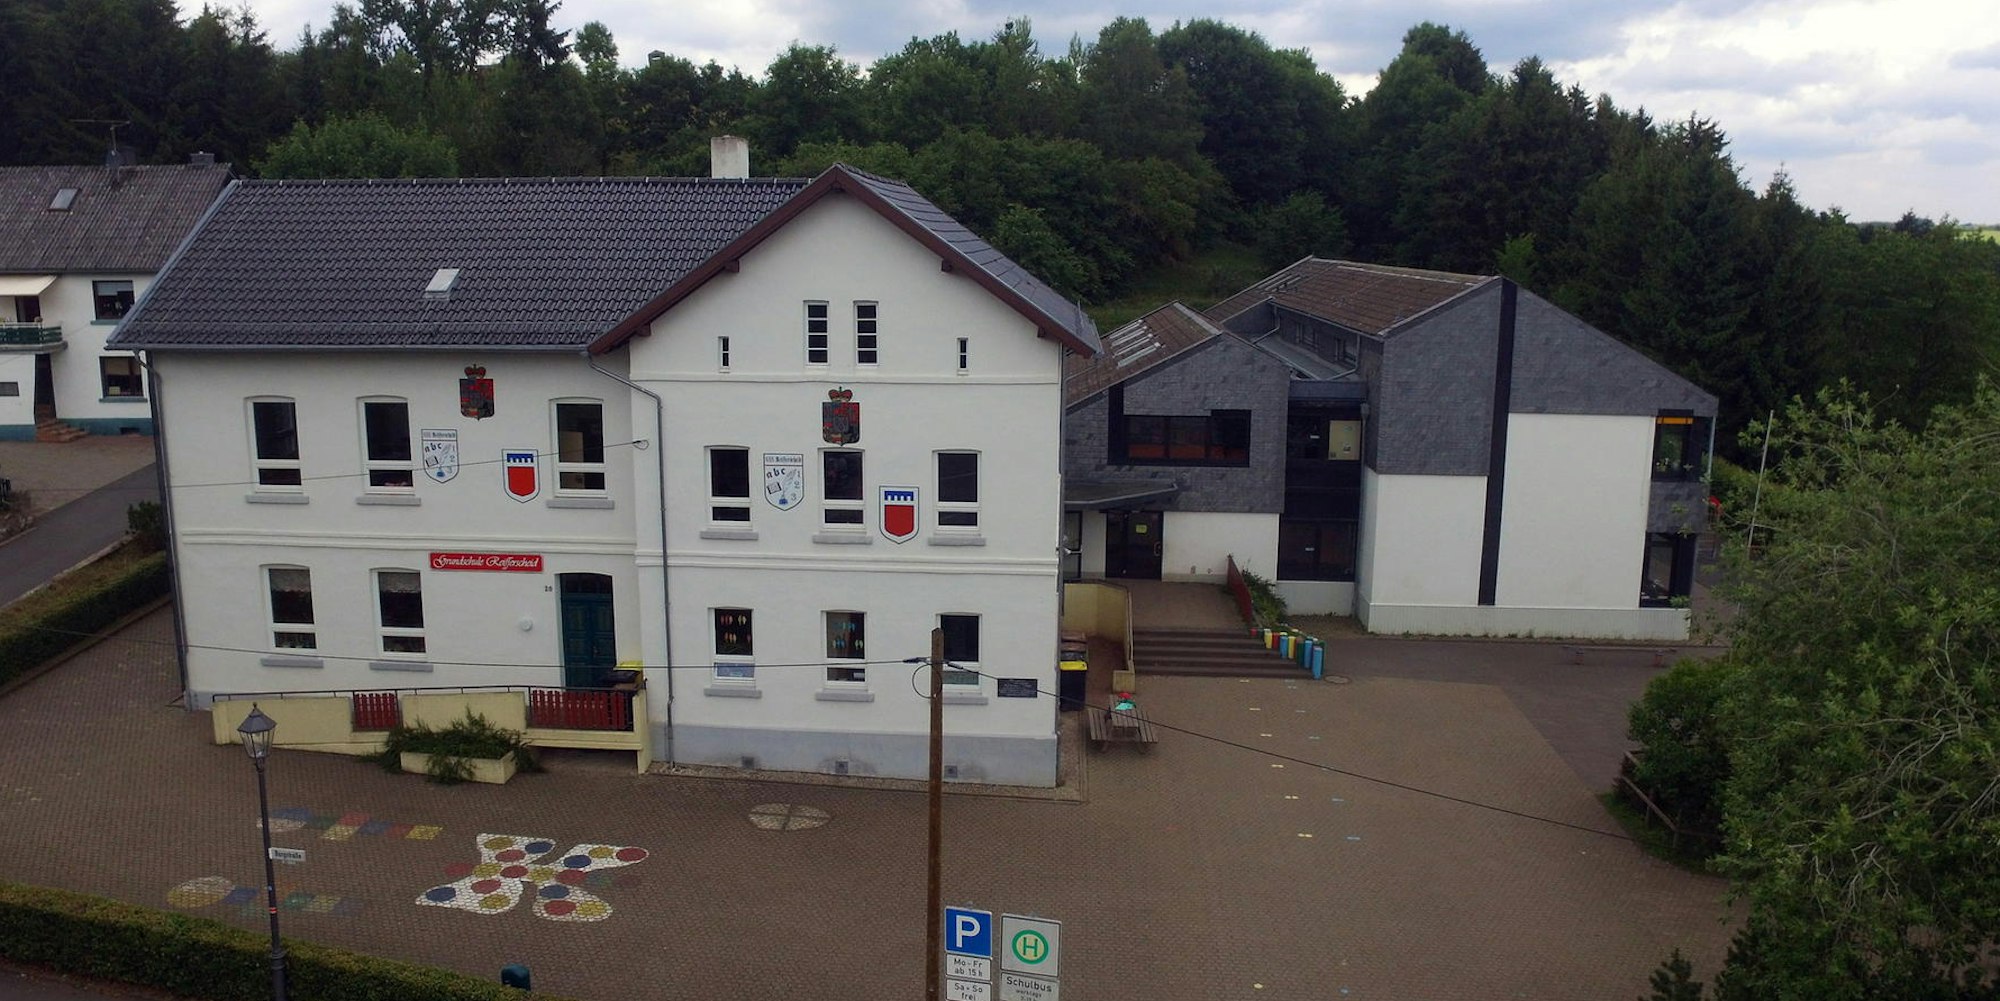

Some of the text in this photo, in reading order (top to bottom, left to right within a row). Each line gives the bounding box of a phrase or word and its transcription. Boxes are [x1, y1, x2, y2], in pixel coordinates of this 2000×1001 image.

[766, 468, 786, 479] abc
[433, 555, 540, 570] Grundschule Reifferscheid
[956, 914, 981, 948] P
[1022, 936, 1039, 957] H
[954, 957, 966, 966] Mo
[973, 960, 983, 968] Fr
[968, 968, 977, 976] 15
[954, 982, 965, 991] Sa
[972, 985, 983, 993] So
[1006, 976, 1052, 992] Schulbus
[961, 992, 977, 1000] frei
